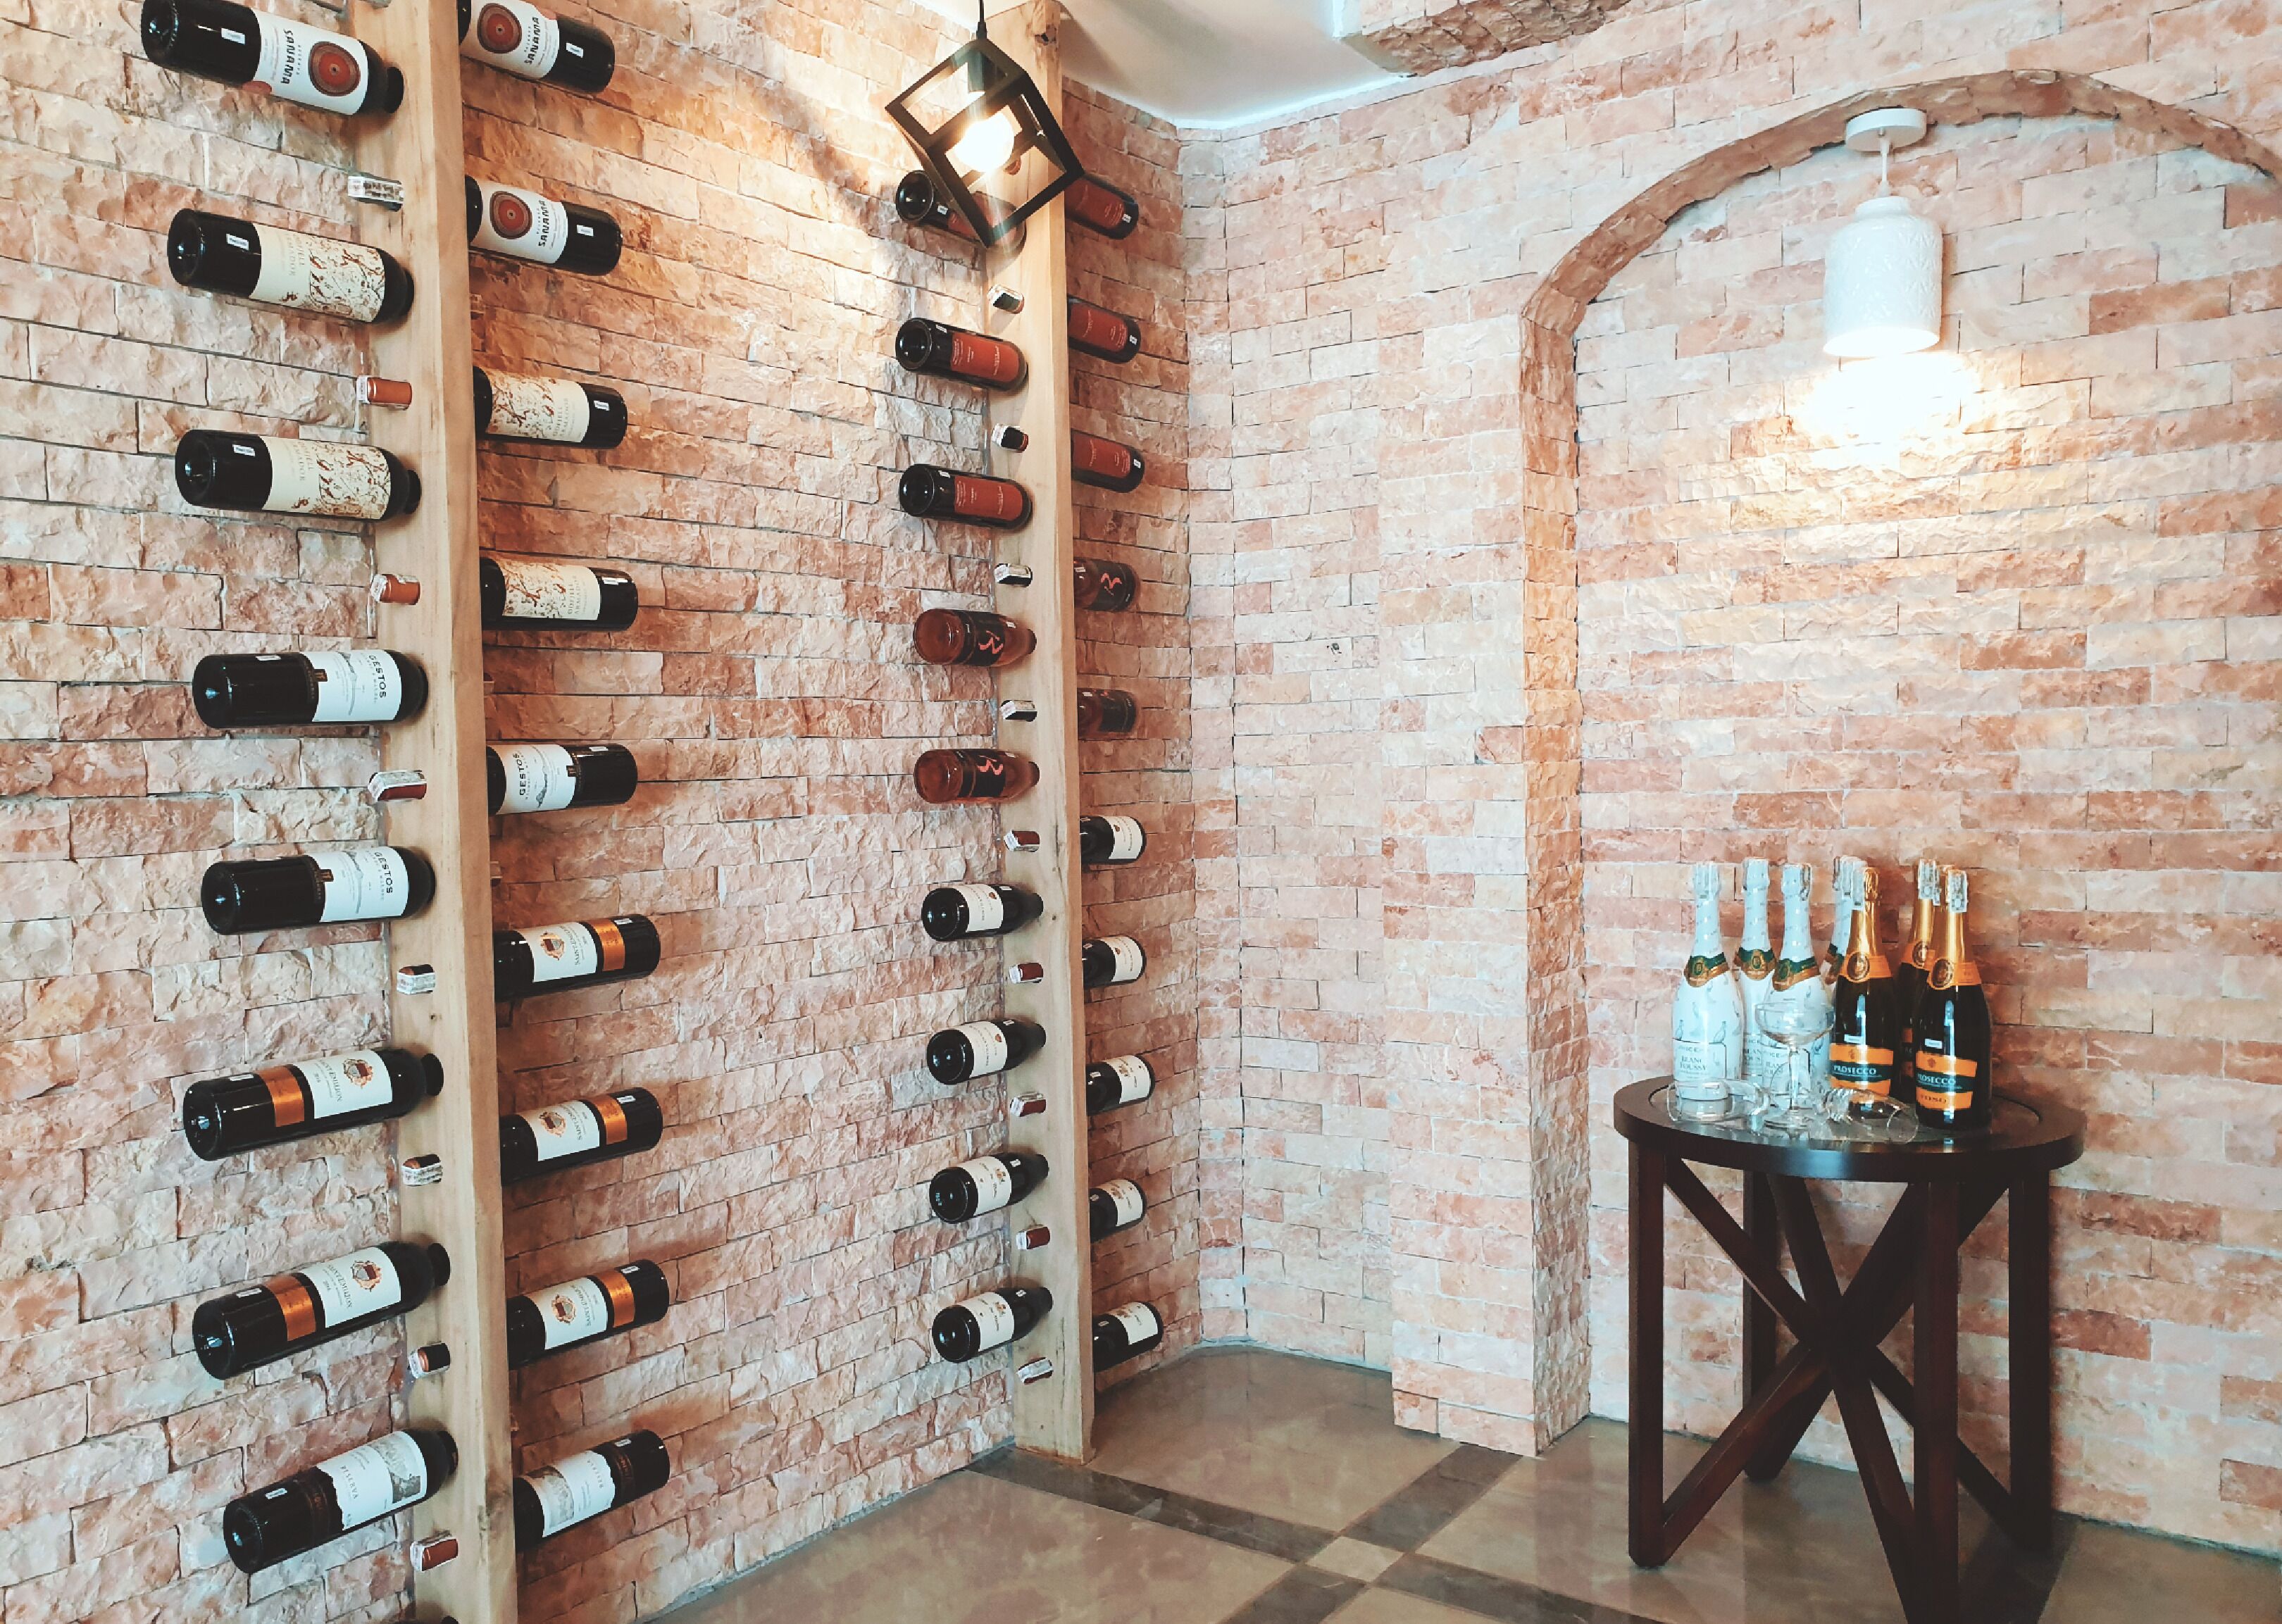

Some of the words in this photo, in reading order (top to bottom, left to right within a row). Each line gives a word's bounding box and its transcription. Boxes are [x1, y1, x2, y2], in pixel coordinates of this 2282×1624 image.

[280, 28, 296, 85] SANAMA
[523, 17, 541, 65] SANAMA
[538, 199, 549, 247] SANAMA
[368, 654, 387, 699] GESTOS
[512, 753, 527, 797] GESTOS
[373, 851, 394, 894] GESTOS
[1833, 1064, 1877, 1075] PROSECCO
[1917, 1073, 1956, 1085] PROSECCO
